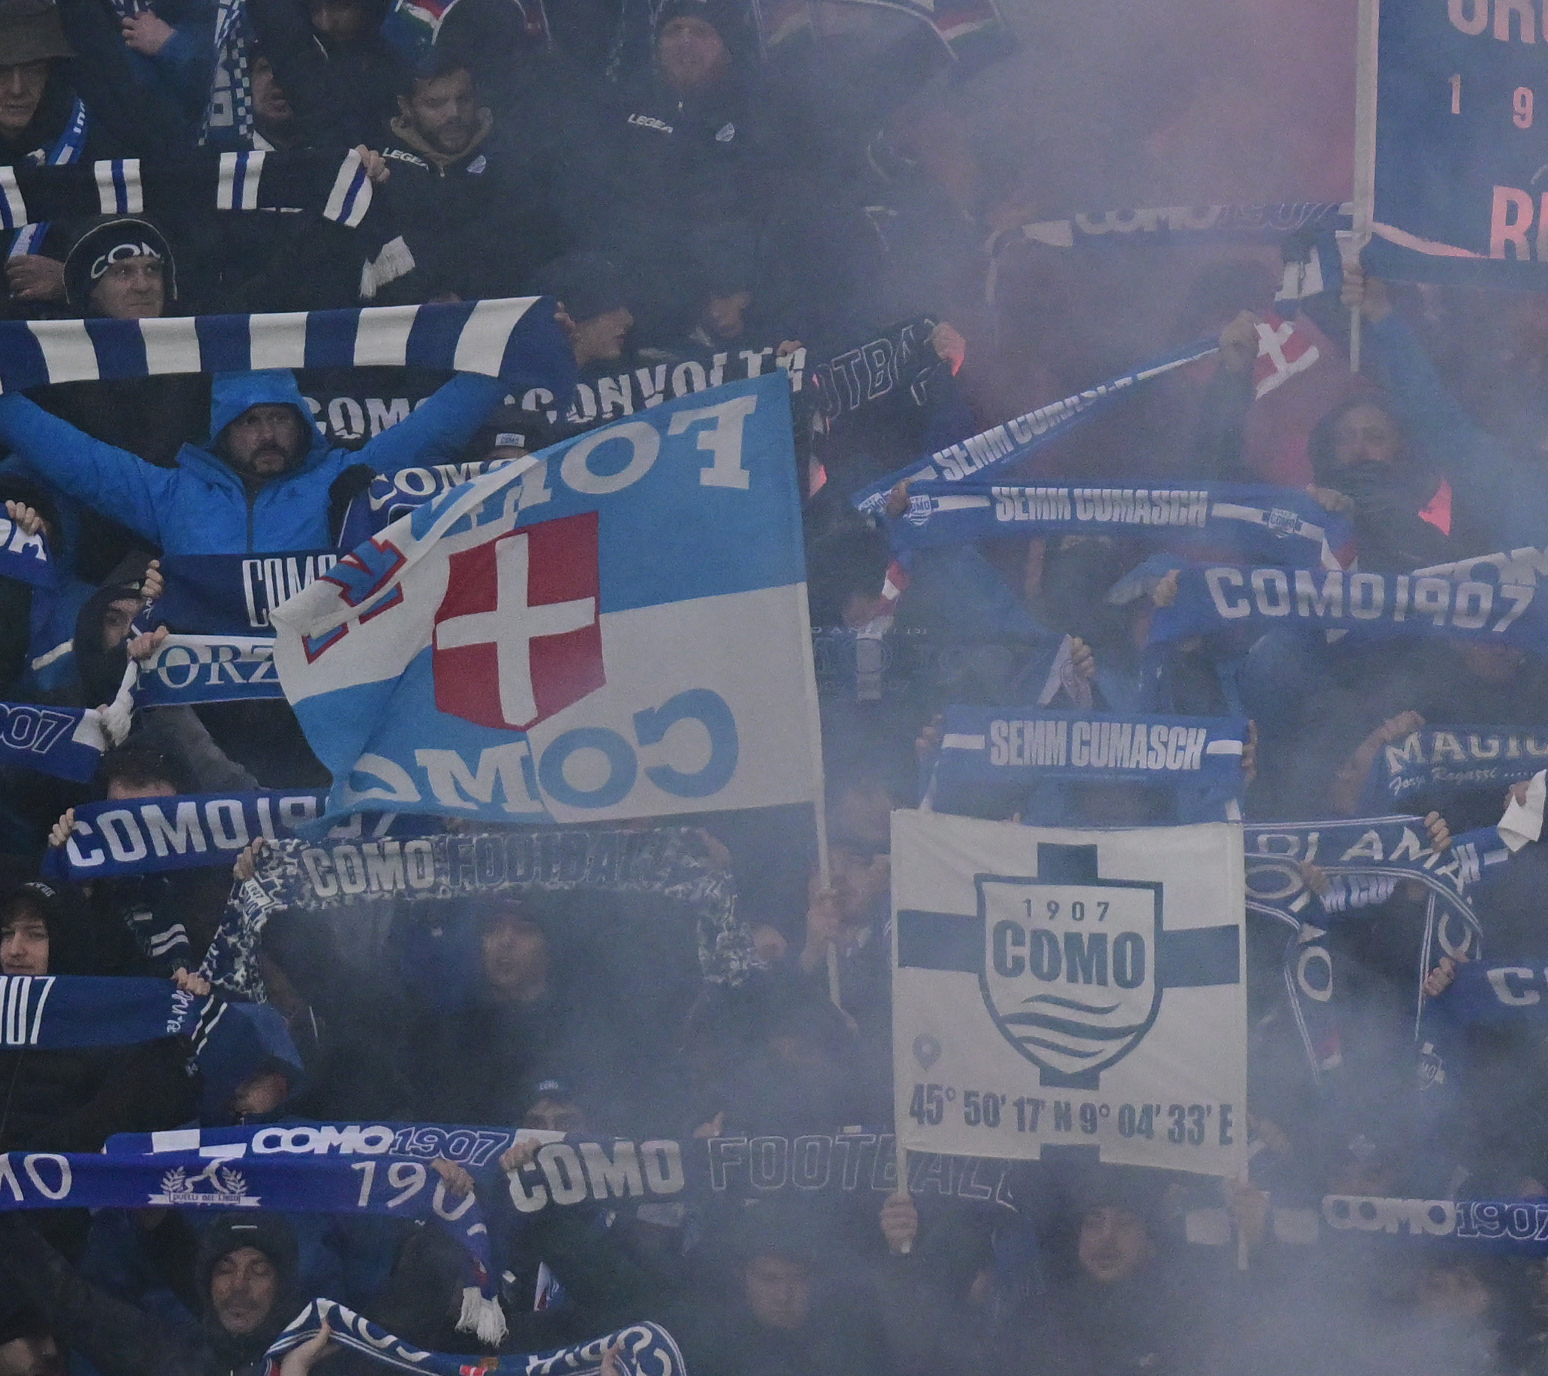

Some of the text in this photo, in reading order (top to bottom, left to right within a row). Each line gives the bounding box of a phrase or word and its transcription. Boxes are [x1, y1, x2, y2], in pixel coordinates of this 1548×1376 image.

[992, 487, 1210, 529] SEMM CUMASCH
[990, 720, 1207, 771] SEMM CUMASCH
[301, 835, 434, 900] COMO
[1023, 898, 1110, 922] 1907
[992, 919, 1146, 990] COMO
[910, 1088, 957, 1128] 45°
[963, 1091, 1009, 1124] 50'
[1012, 1095, 1047, 1126] 17'
[1054, 1098, 1073, 1131] N
[1078, 1101, 1111, 1134] 9°
[1119, 1105, 1165, 1138] 04'
[1218, 1109, 1234, 1143] E
[508, 1136, 686, 1215] COMO
